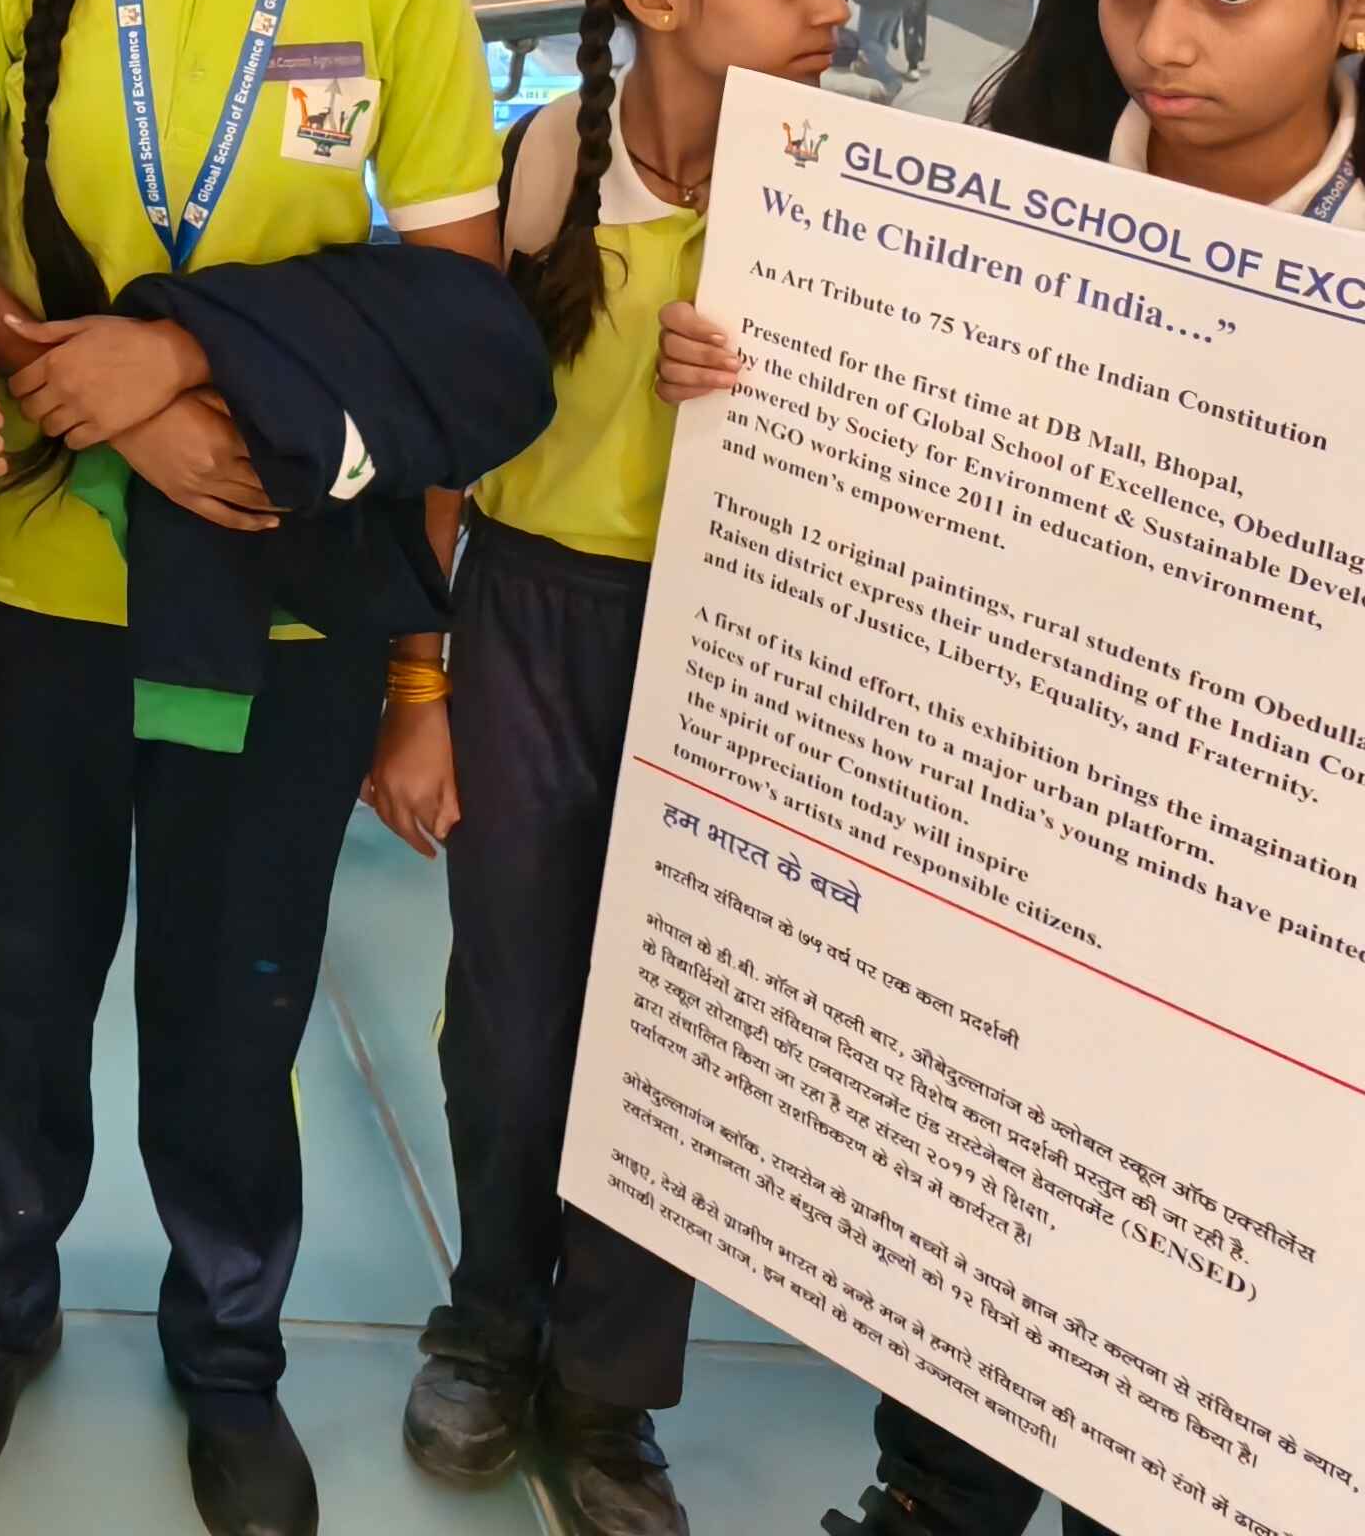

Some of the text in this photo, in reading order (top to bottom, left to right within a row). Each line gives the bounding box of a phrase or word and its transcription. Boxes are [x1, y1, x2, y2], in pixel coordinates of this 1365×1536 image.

[129, 30, 159, 202] Global School of Excellence
[198, 38, 265, 203] Global School of Excellence
[762, 185, 811, 230] We,
[821, 207, 867, 242] the
[876, 222, 1023, 286] Children
[1034, 271, 1071, 300] of
[844, 141, 1263, 278] GLOBAL SCHOOL OF
[741, 317, 1243, 498] Presented for the first time at DB Mall, Bhopal,
[749, 259, 1327, 450] An Art Tribute to 75 Years of the Indian Constitution
[662, 801, 862, 914] हम भारत के बच्चे
[673, 743, 1101, 949] tomorrow’s artists and responsible citizens.
[654, 859, 1020, 1050] भारतीय संविधान के ७५ वर्ष पर एक कला प्रदर्शनी
